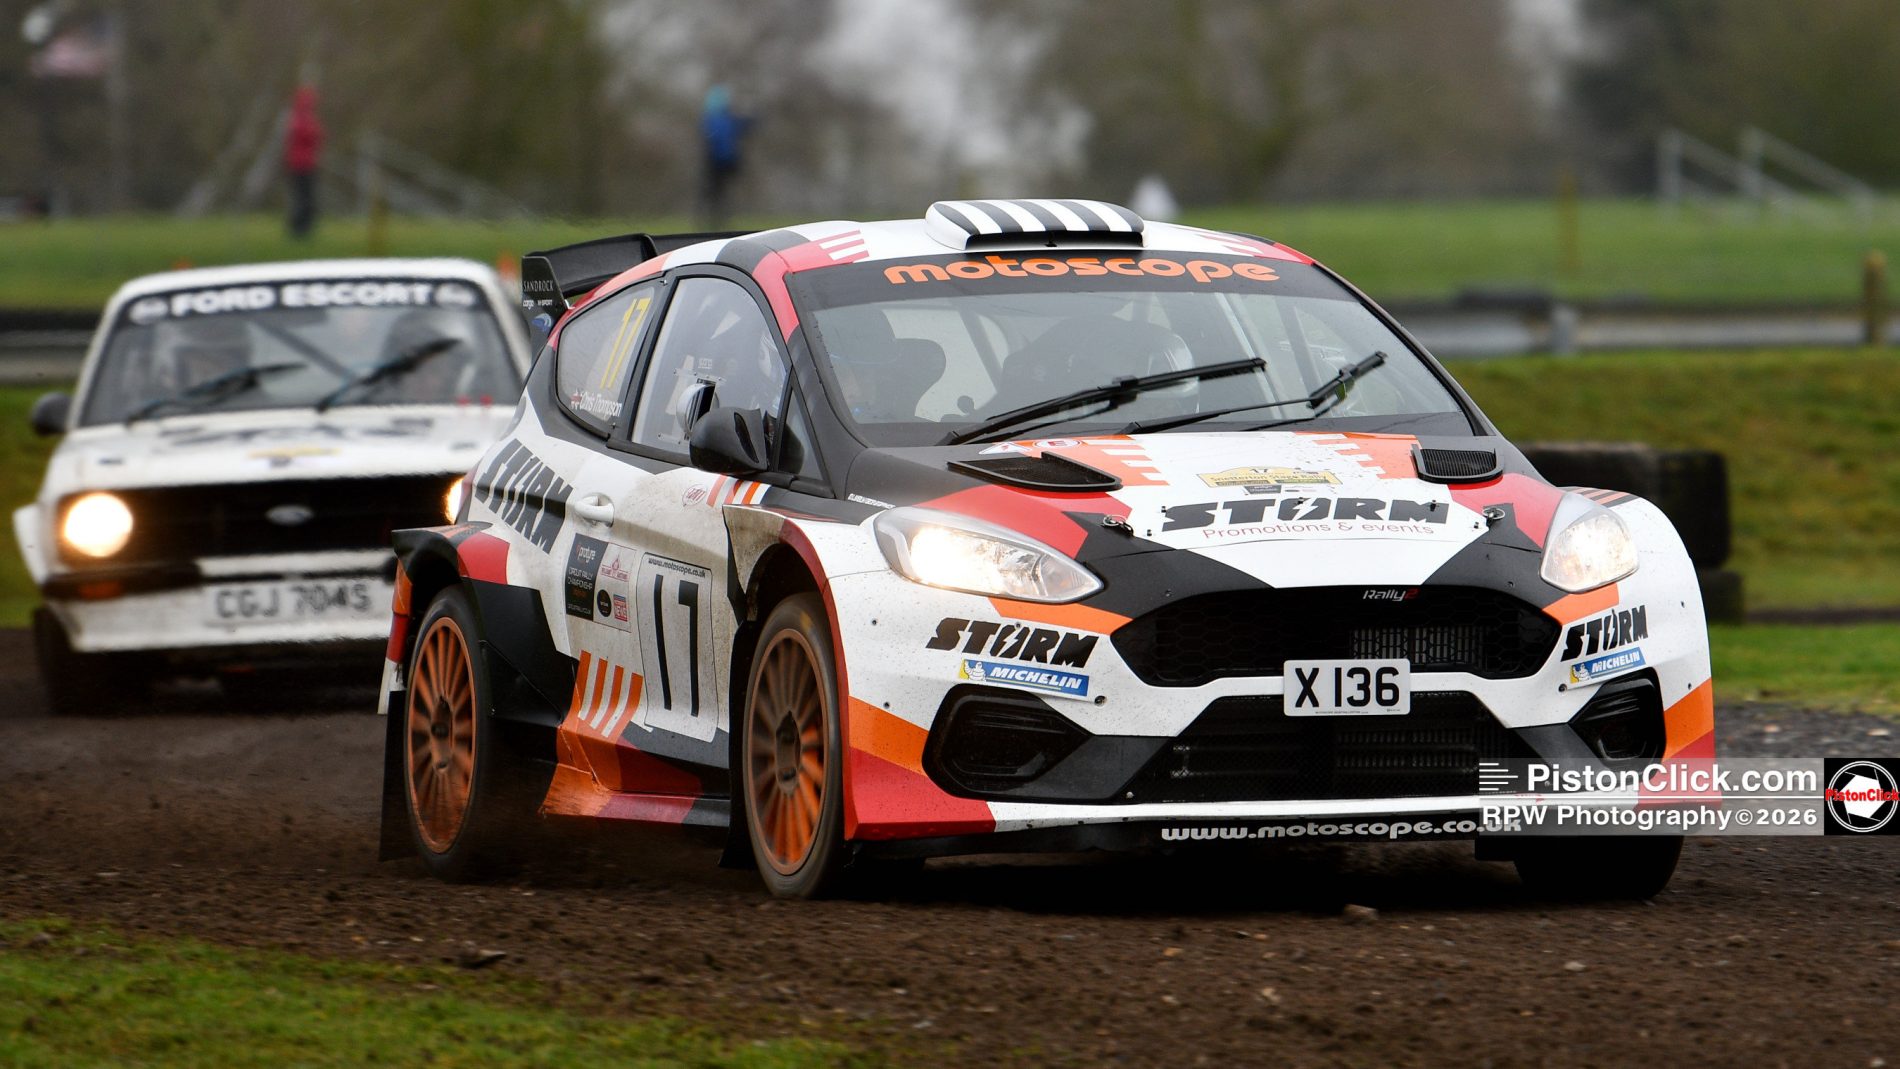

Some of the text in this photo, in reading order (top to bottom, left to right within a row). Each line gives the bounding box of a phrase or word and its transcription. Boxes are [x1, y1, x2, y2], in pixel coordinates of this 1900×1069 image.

[883, 255, 1281, 283] motoscope
[171, 285, 275, 317] FORD
[280, 282, 431, 307] ESCORT
[523, 280, 554, 292] SANDROCK
[600, 298, 650, 390] 17
[1203, 521, 1434, 539] Promotions & events
[215, 583, 372, 619] CGJ 704S
[653, 574, 699, 717] 17
[989, 665, 1082, 690] MICHELIN
[1591, 651, 1641, 673] MICHELIN
[1295, 666, 1400, 708] X 136
